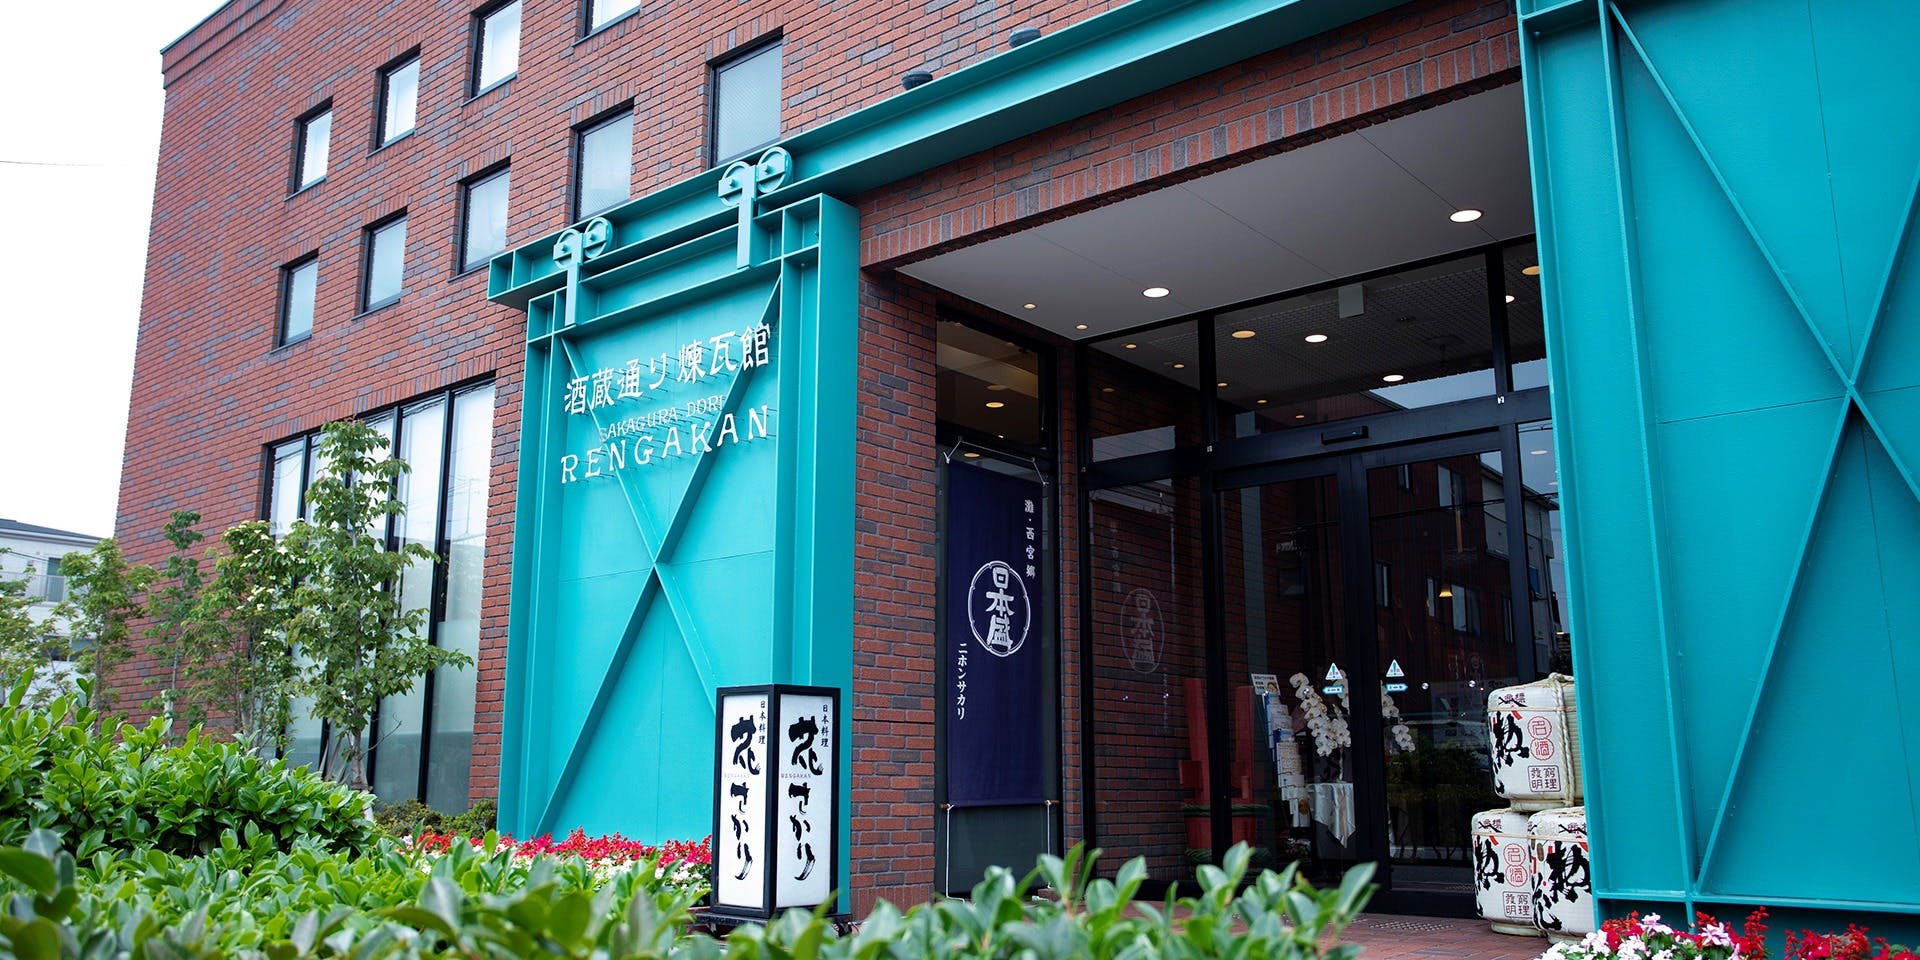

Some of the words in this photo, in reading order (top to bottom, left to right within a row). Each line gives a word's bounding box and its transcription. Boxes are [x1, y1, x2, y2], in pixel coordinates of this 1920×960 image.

[564, 322, 770, 415] 酒蔵通り煉瓦館
[561, 404, 768, 484] RENGAKAN
[600, 406, 678, 443] SAKAGURA
[687, 394, 726, 418] DORI
[985, 567, 1015, 650] 日本盛
[956, 643, 968, 720] ニホンサカリ
[758, 701, 767, 745] 日本料理
[820, 704, 829, 748] 日本料理
[731, 715, 761, 881] 花さかり
[788, 715, 823, 881] 花さかり
